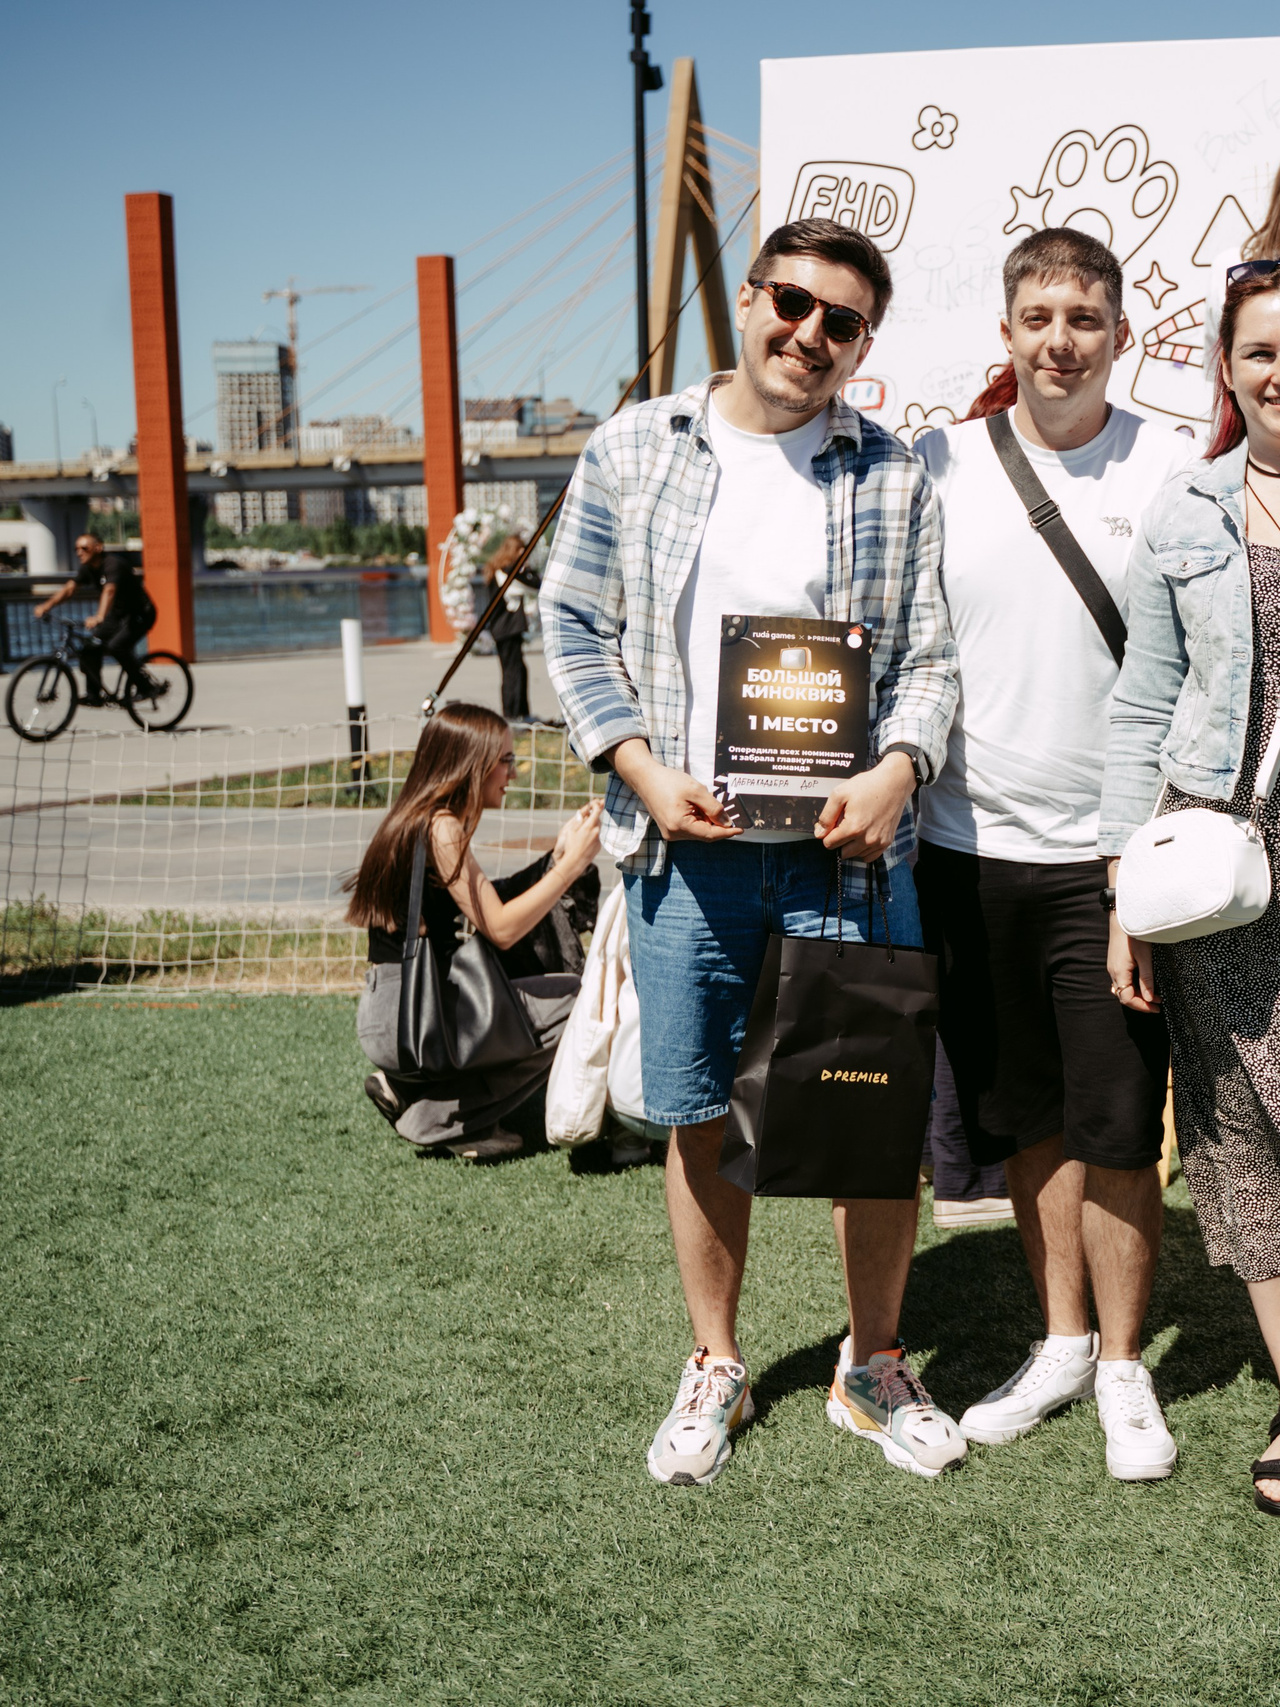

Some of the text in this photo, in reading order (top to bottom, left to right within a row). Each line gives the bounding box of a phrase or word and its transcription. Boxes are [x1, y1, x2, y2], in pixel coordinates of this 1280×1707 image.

[799, 175, 898, 237] FHD
[770, 632, 796, 641] games
[747, 668, 842, 688] БОЛЬШОЙ
[742, 684, 846, 704] КИНОКВИЗ
[748, 715, 838, 735] 1 МЕСТО
[728, 745, 855, 760] Опередила всех номинантов
[739, 754, 775, 764] забрала
[776, 757, 814, 766] главную
[815, 759, 851, 769] награду
[772, 764, 811, 773] команда
[833, 1070, 889, 1085] PREMIER
